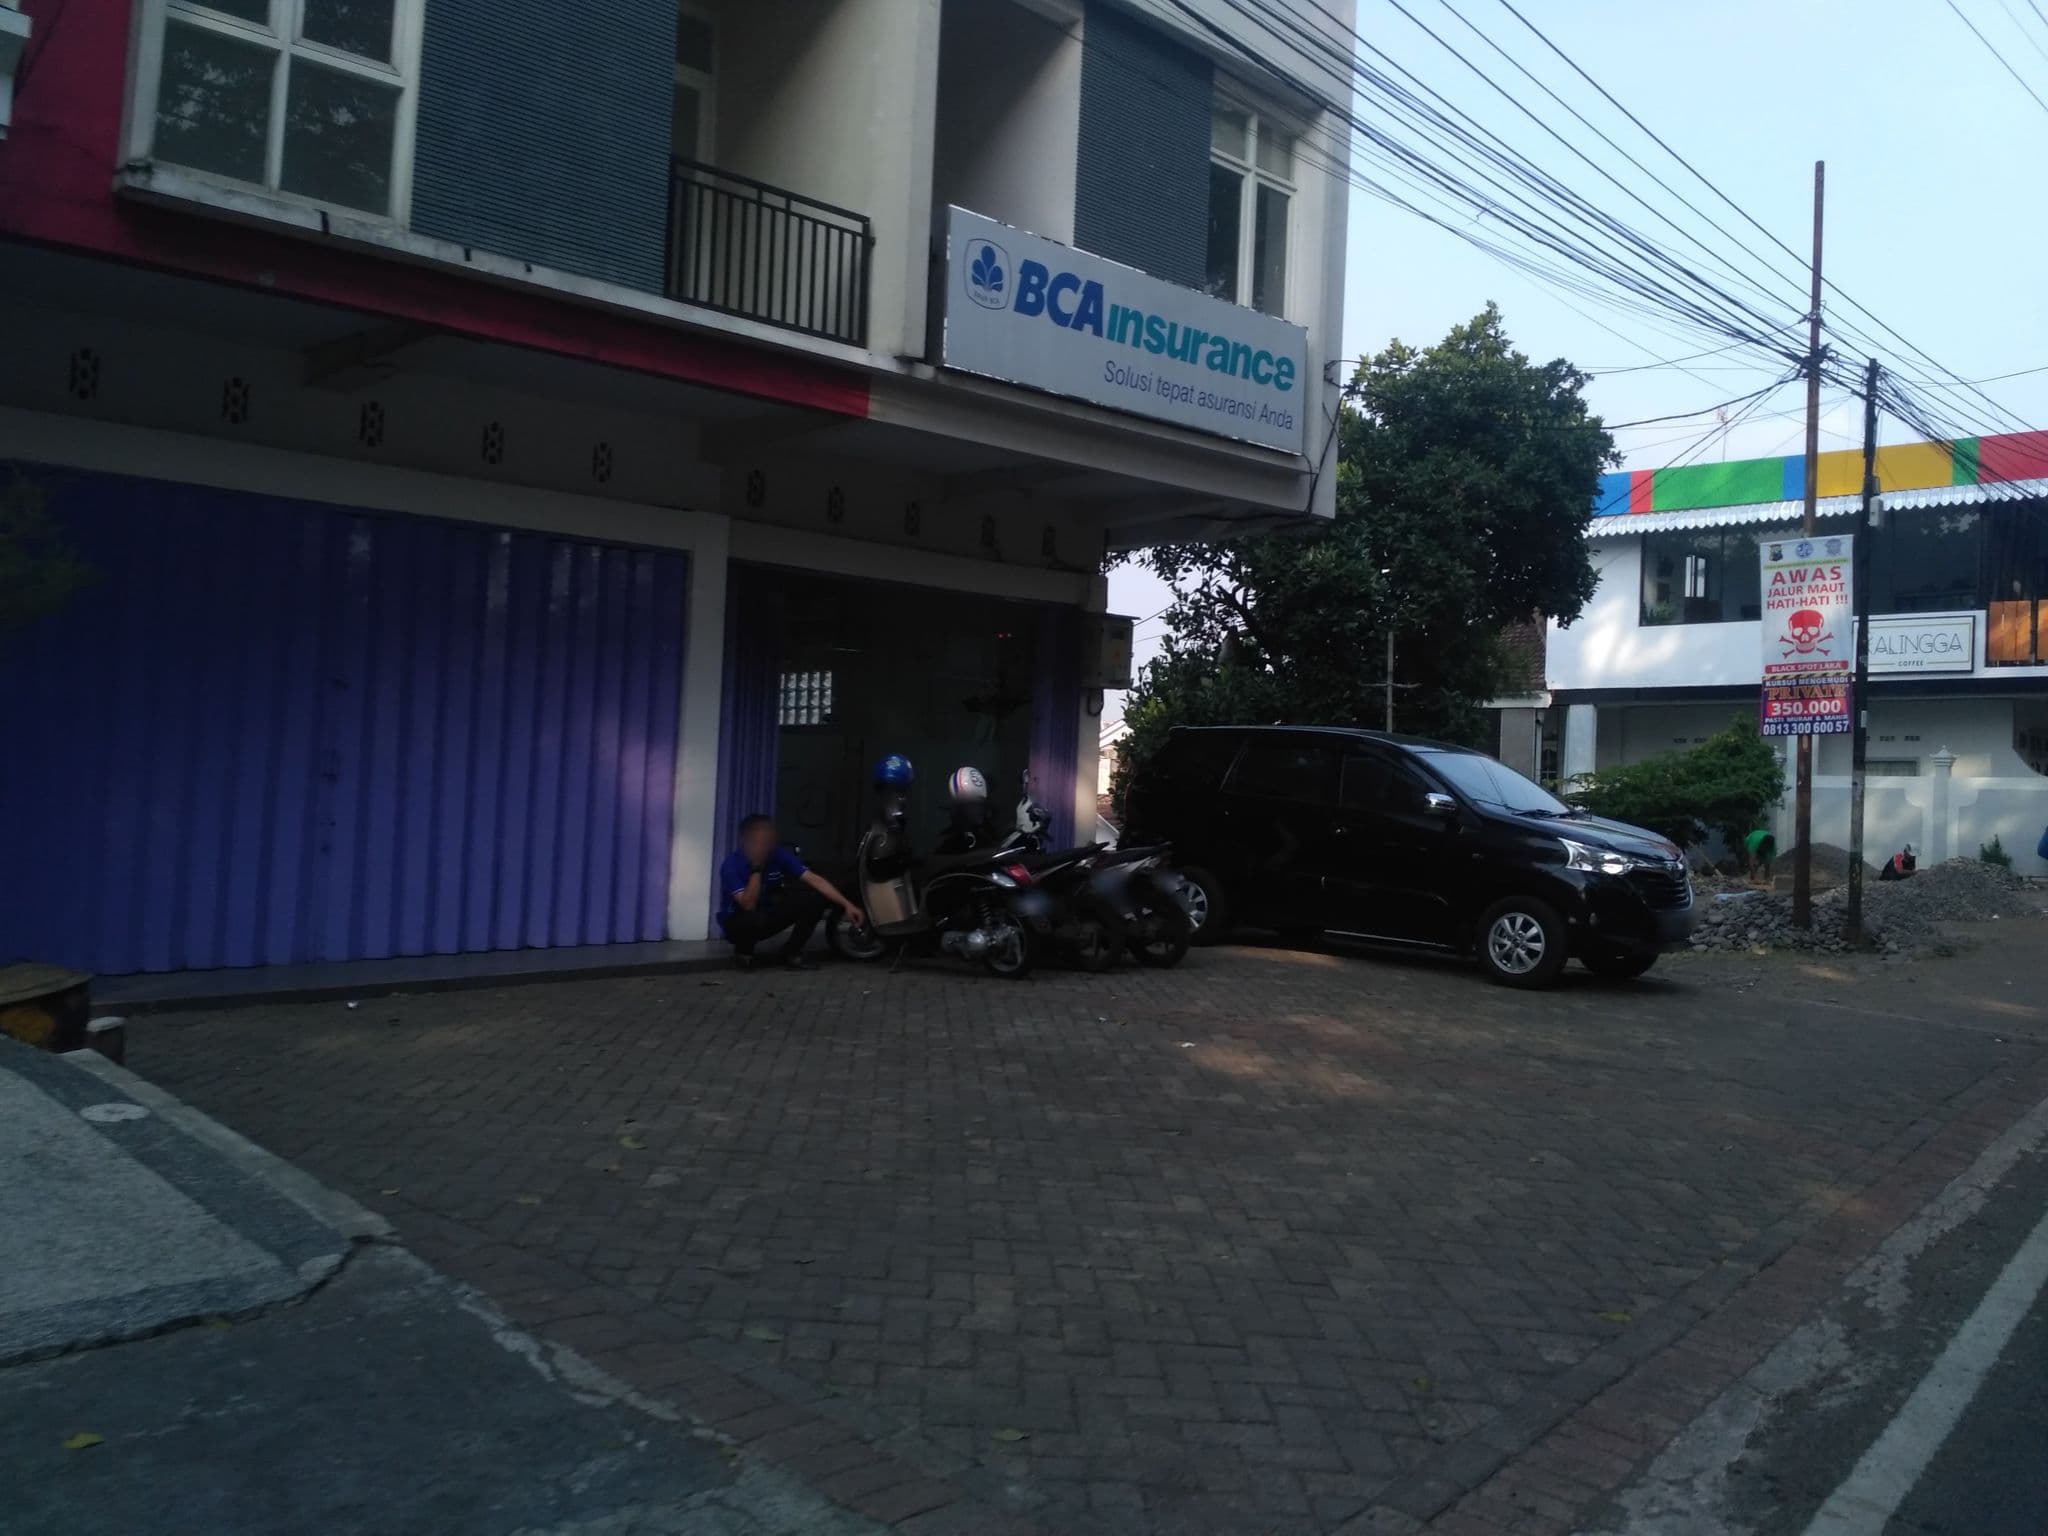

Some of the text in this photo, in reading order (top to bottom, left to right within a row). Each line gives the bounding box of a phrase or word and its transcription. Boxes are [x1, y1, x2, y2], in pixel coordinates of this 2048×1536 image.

[1104, 360, 1293, 430] Solusi tepat asuransi Anda
[1772, 566, 1842, 586] AWAS
[1768, 583, 1845, 598] JALUR MAUT
[1767, 596, 1829, 609] HATI-HATI
[1771, 664, 1795, 673] BLACK
[1798, 663, 1817, 671] SPOT
[1766, 677, 1848, 687] KURSUS MENGEMUDI
[1771, 700, 1841, 716] 350.000
[1763, 720, 1849, 735] 0813 300 600 57
